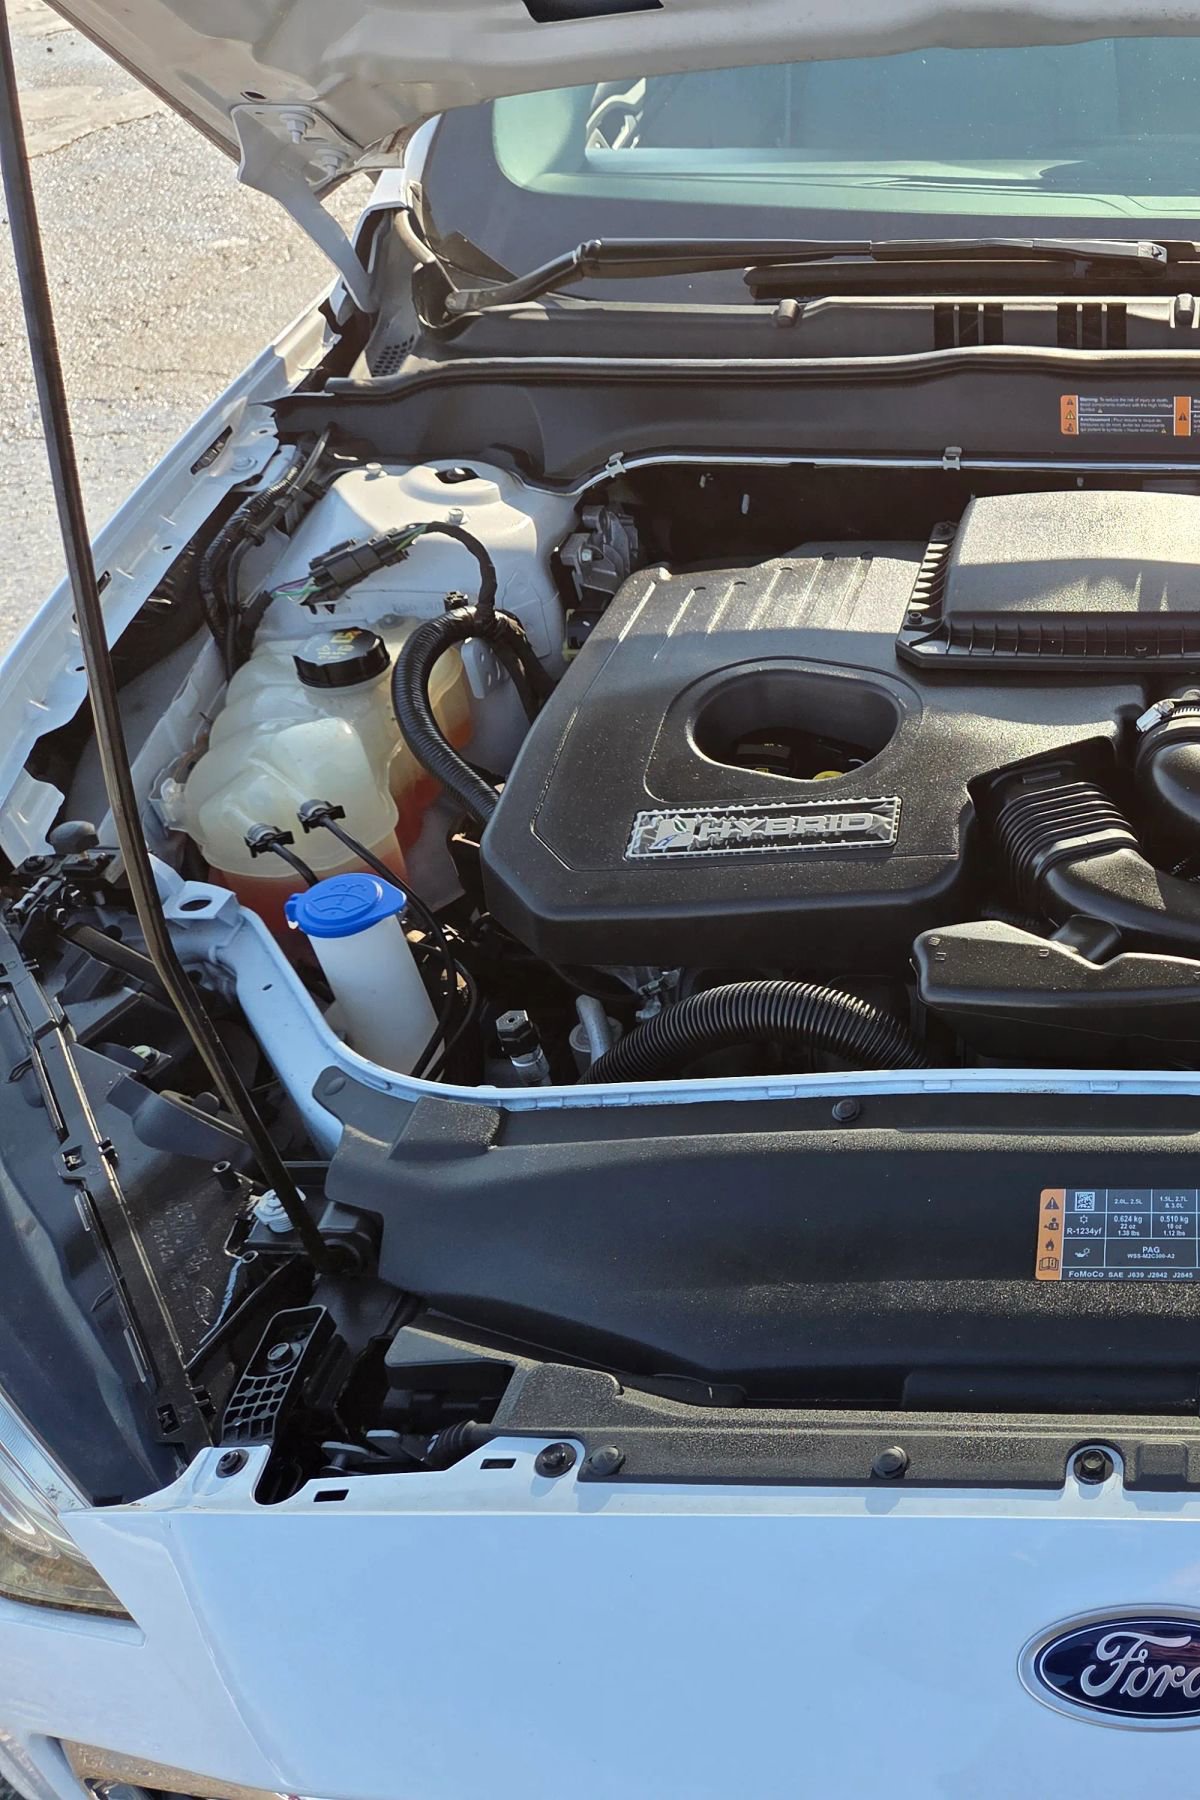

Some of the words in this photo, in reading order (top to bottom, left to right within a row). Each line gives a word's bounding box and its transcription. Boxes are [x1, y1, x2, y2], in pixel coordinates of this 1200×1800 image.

[699, 812, 874, 841] HYBRID
[1134, 1215, 1142, 1224] kg
[1180, 1216, 1189, 1224] kg
[1067, 1227, 1102, 1236] R-1234yf
